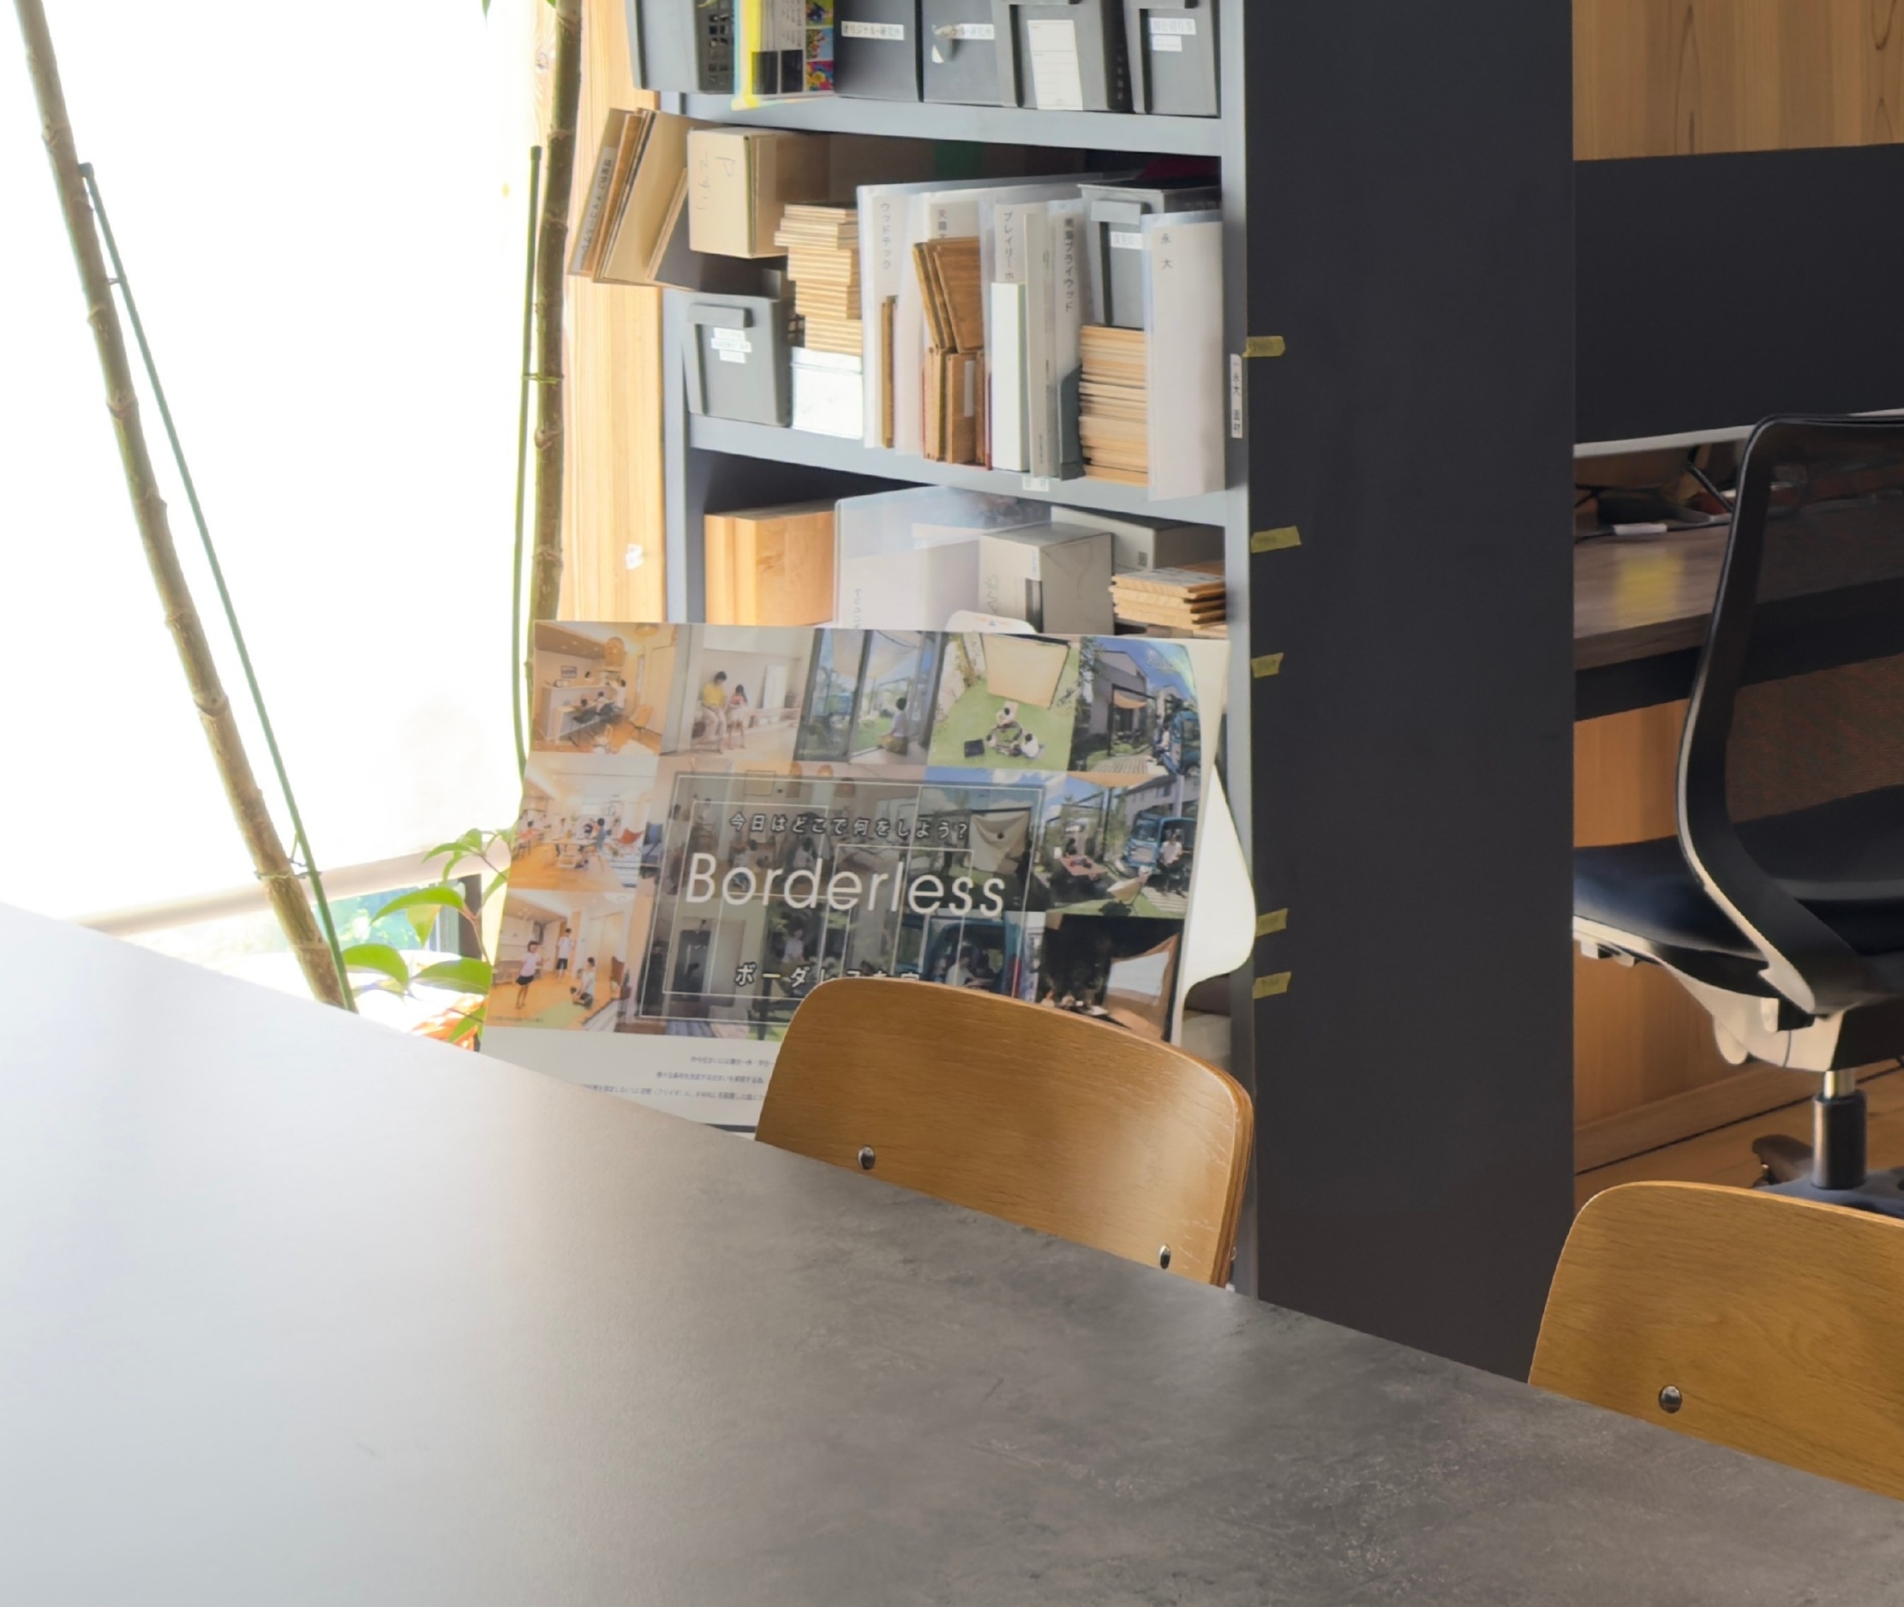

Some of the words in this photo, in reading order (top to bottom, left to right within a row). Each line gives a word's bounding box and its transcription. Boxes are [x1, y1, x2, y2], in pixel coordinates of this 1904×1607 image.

[730, 813, 968, 840] 今日はどこで何をしよう?
[685, 853, 1006, 918] Borderless
